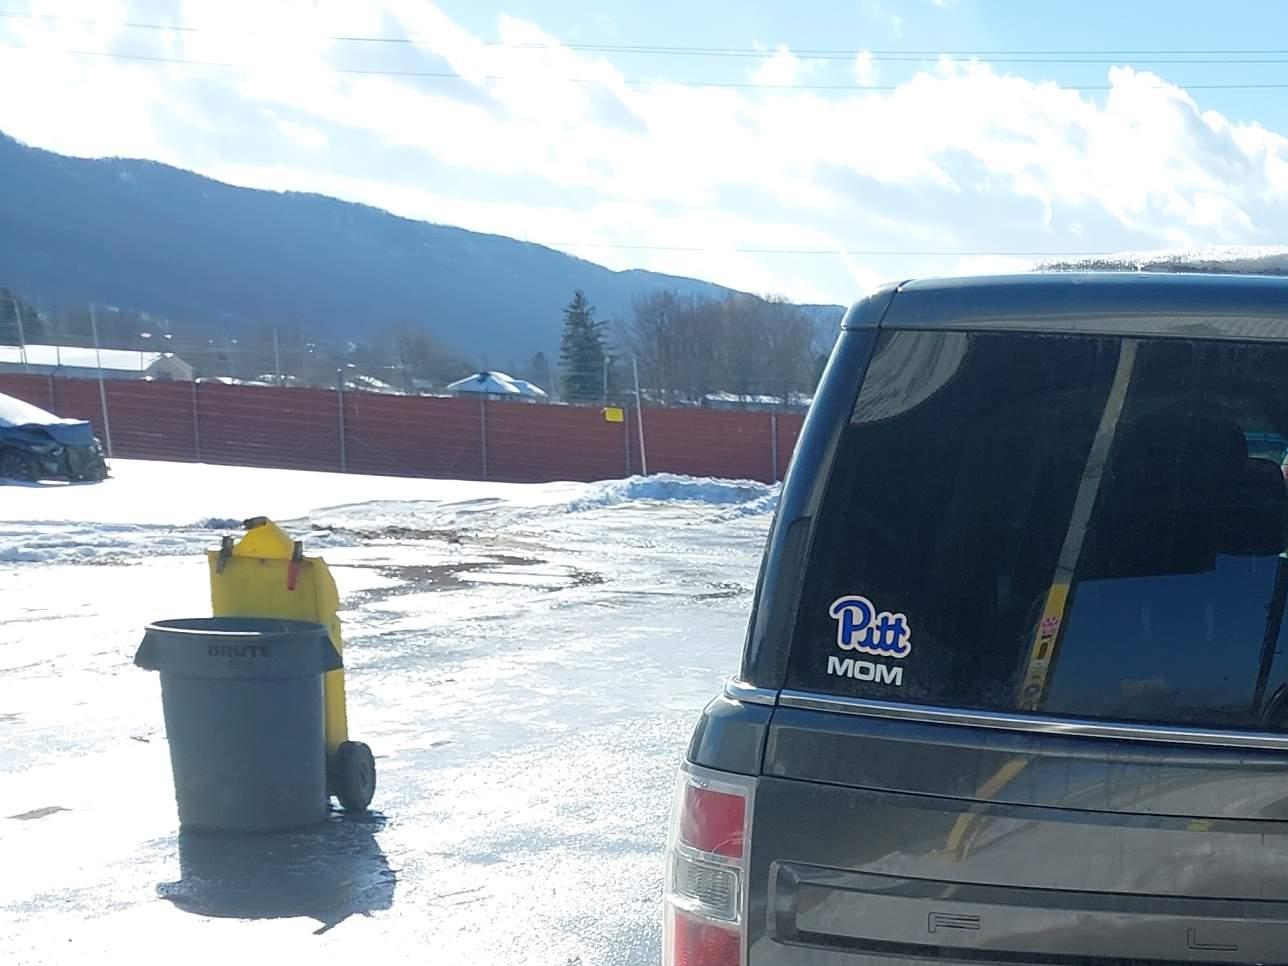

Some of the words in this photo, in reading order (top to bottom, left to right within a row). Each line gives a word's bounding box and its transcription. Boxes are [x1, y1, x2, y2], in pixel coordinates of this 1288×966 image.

[830, 596, 910, 657] Pitt
[207, 644, 273, 658] BRUTE
[827, 656, 903, 686] MOM
